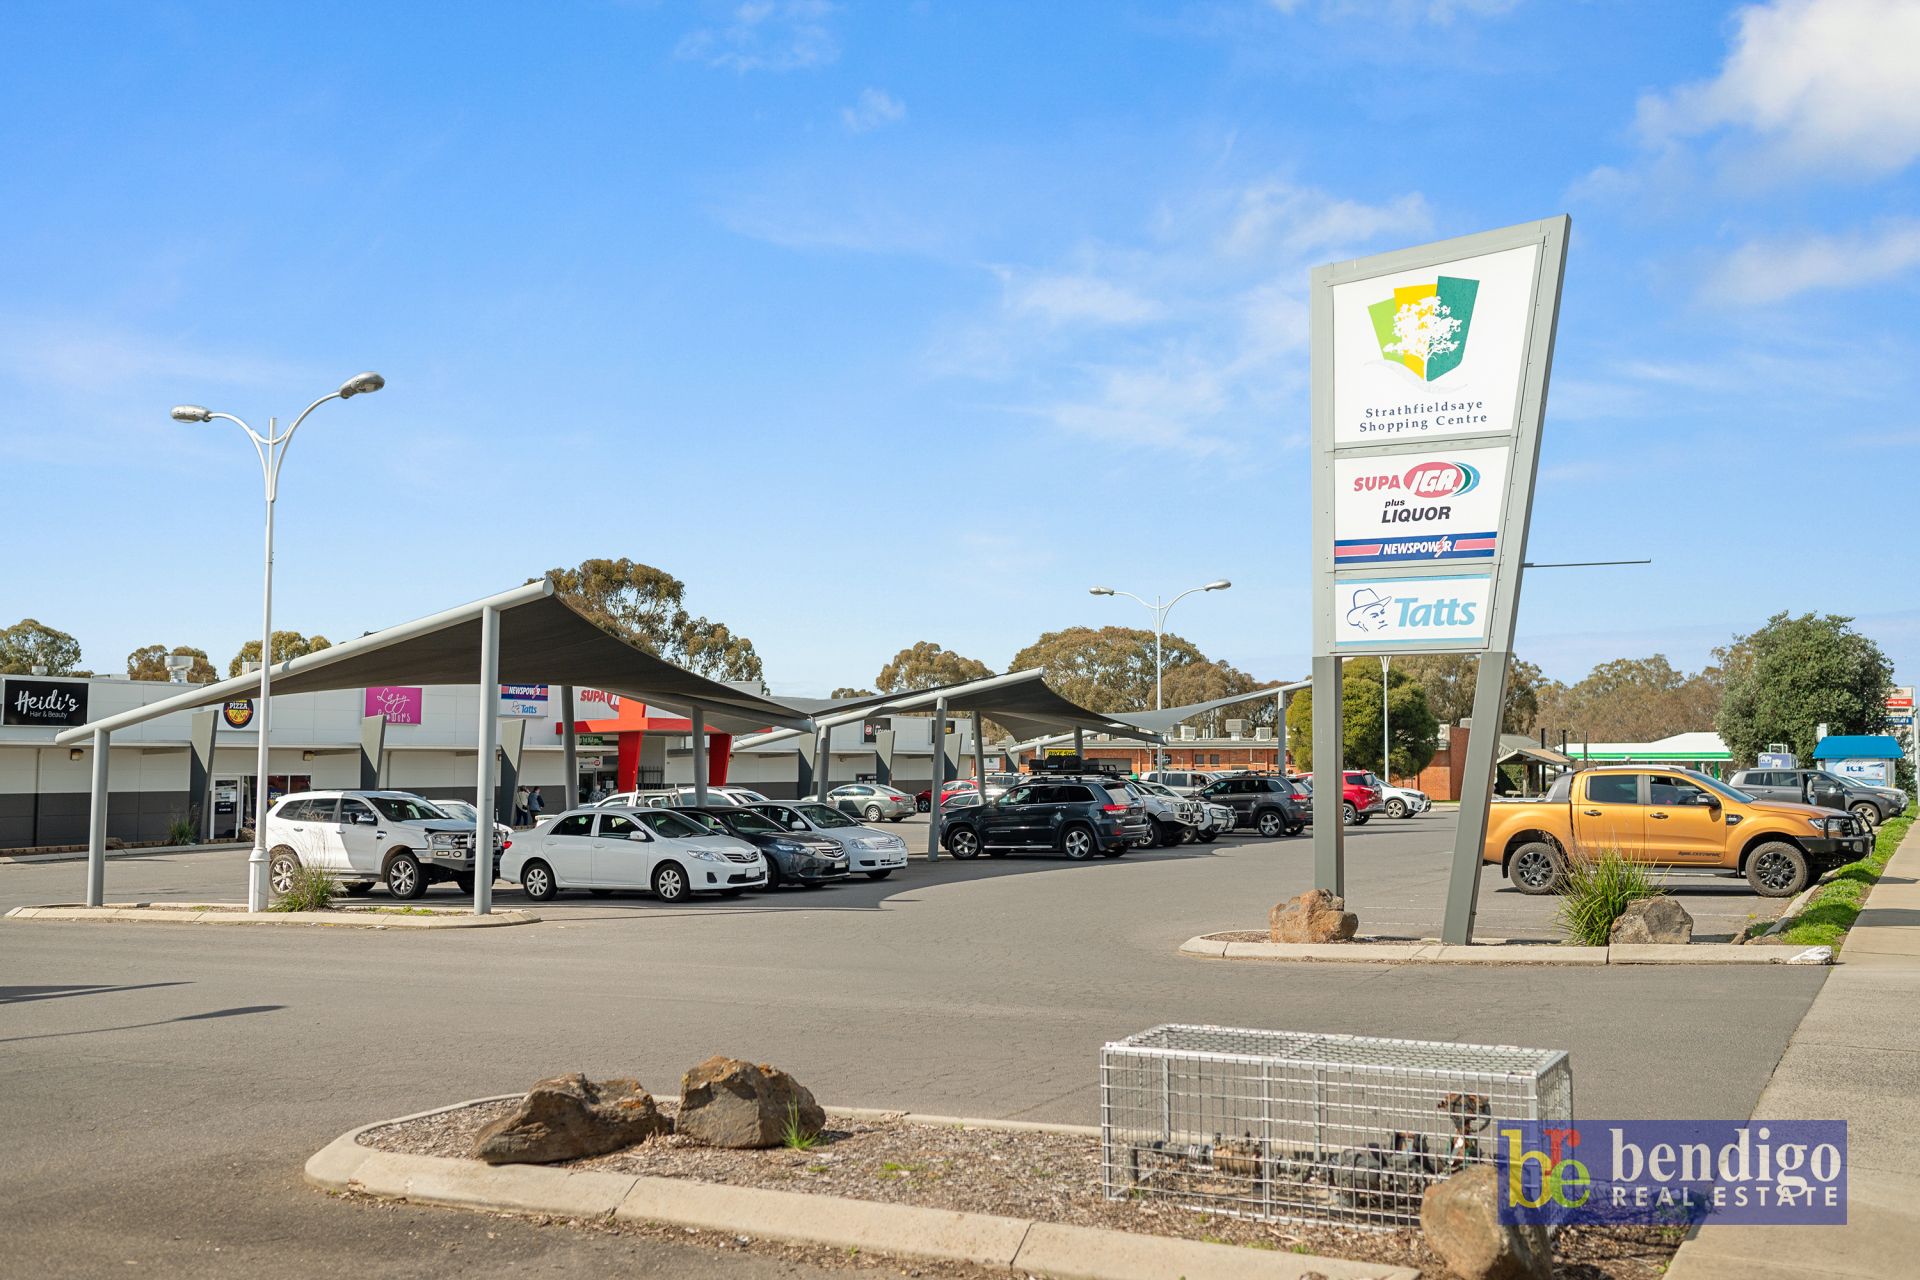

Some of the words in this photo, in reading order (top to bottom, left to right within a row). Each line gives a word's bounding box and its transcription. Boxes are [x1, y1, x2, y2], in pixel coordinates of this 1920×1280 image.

[1365, 401, 1483, 419] Strathfieldsaye
[1359, 418, 1429, 433] Shopping
[1436, 414, 1488, 427] Centre
[1353, 475, 1401, 492] SUPA
[1409, 468, 1458, 495] IGA
[1384, 499, 1405, 508] plus
[1381, 506, 1452, 524] LIQUOR
[1383, 537, 1453, 557] NEWSPOWER
[1394, 597, 1477, 628] Tatts
[14, 689, 79, 714] Heidi's
[580, 690, 606, 703] SUPA
[29, 710, 42, 718] Hair
[48, 710, 68, 720] Beauty
[520, 704, 537, 714] Tatts
